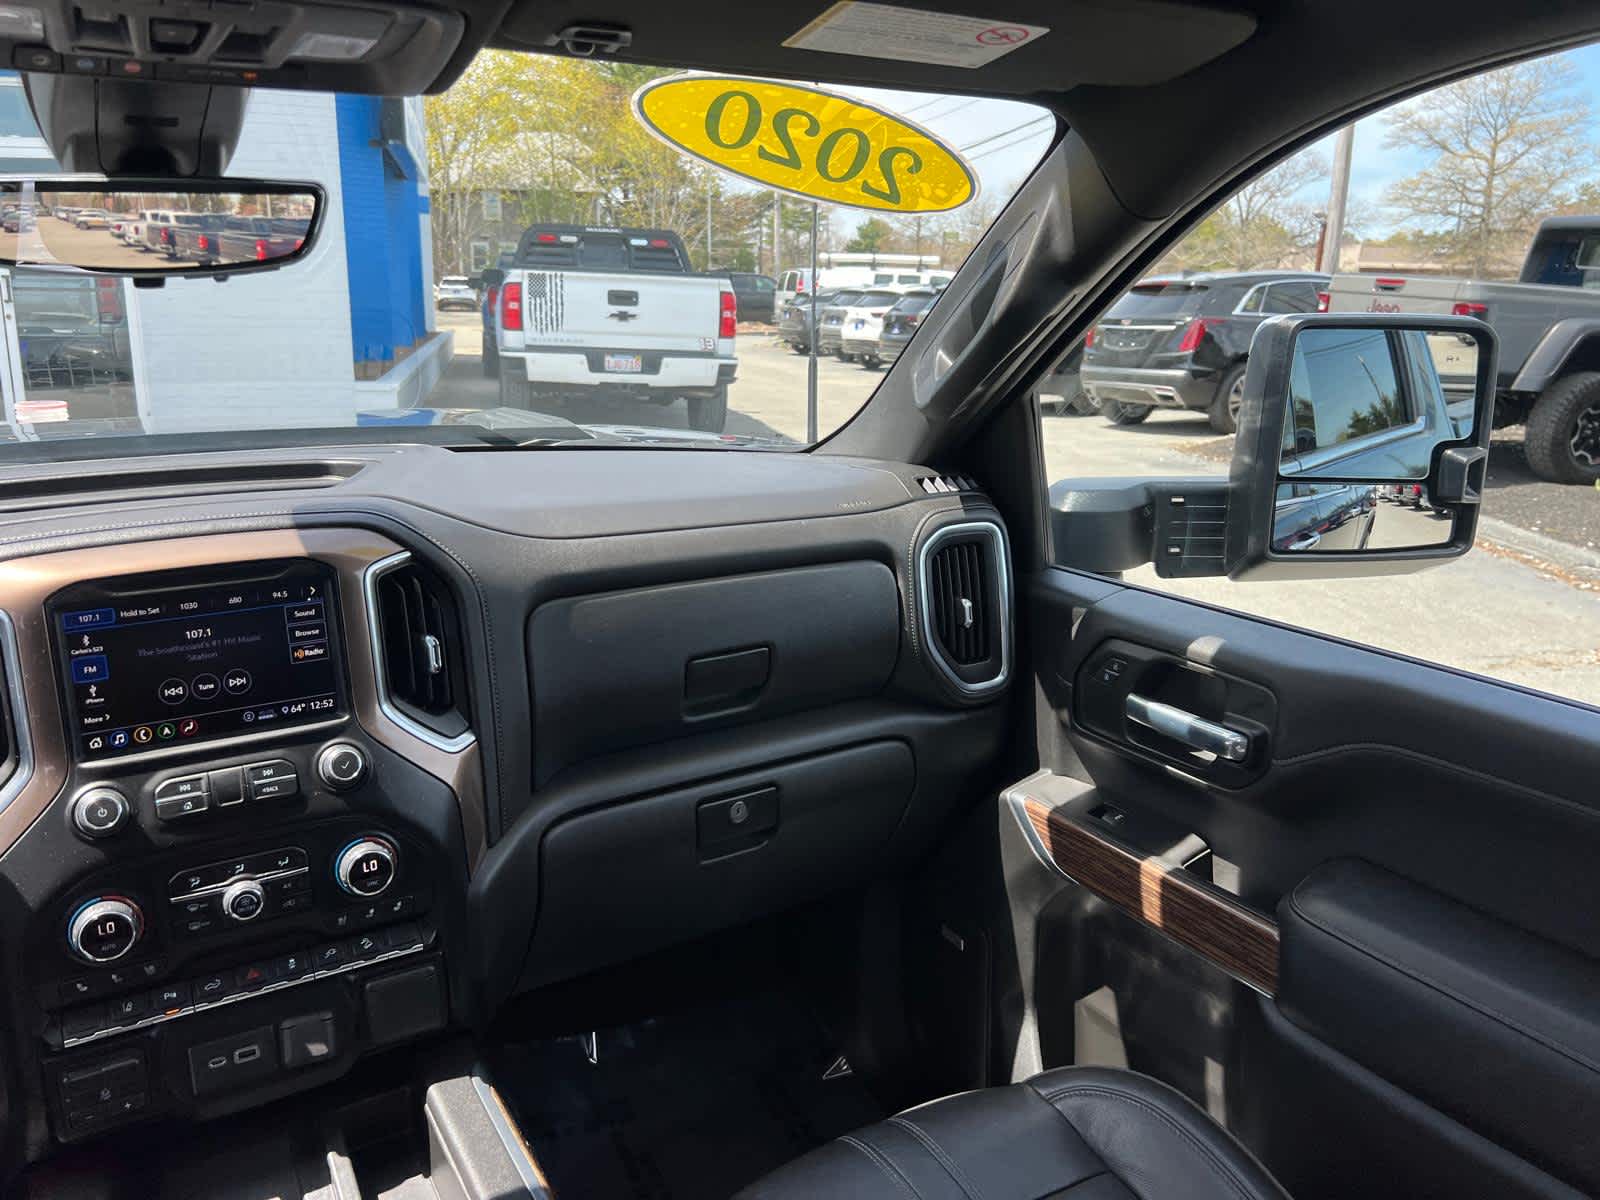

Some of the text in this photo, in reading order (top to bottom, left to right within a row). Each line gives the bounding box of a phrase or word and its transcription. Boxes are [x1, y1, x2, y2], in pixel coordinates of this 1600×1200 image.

[1366, 298, 1401, 312] Jeep
[272, 591, 288, 599] 94.5
[180, 601, 198, 610] 1030
[120, 609, 138, 617] Hold
[294, 608, 316, 617] Sound
[79, 614, 100, 622] 107.1
[185, 628, 212, 640] 107.1
[295, 629, 320, 637] Browse
[83, 665, 97, 674] FM
[291, 699, 334, 713] 64° 12:52
[362, 859, 378, 873] LO
[97, 921, 116, 936] LO
